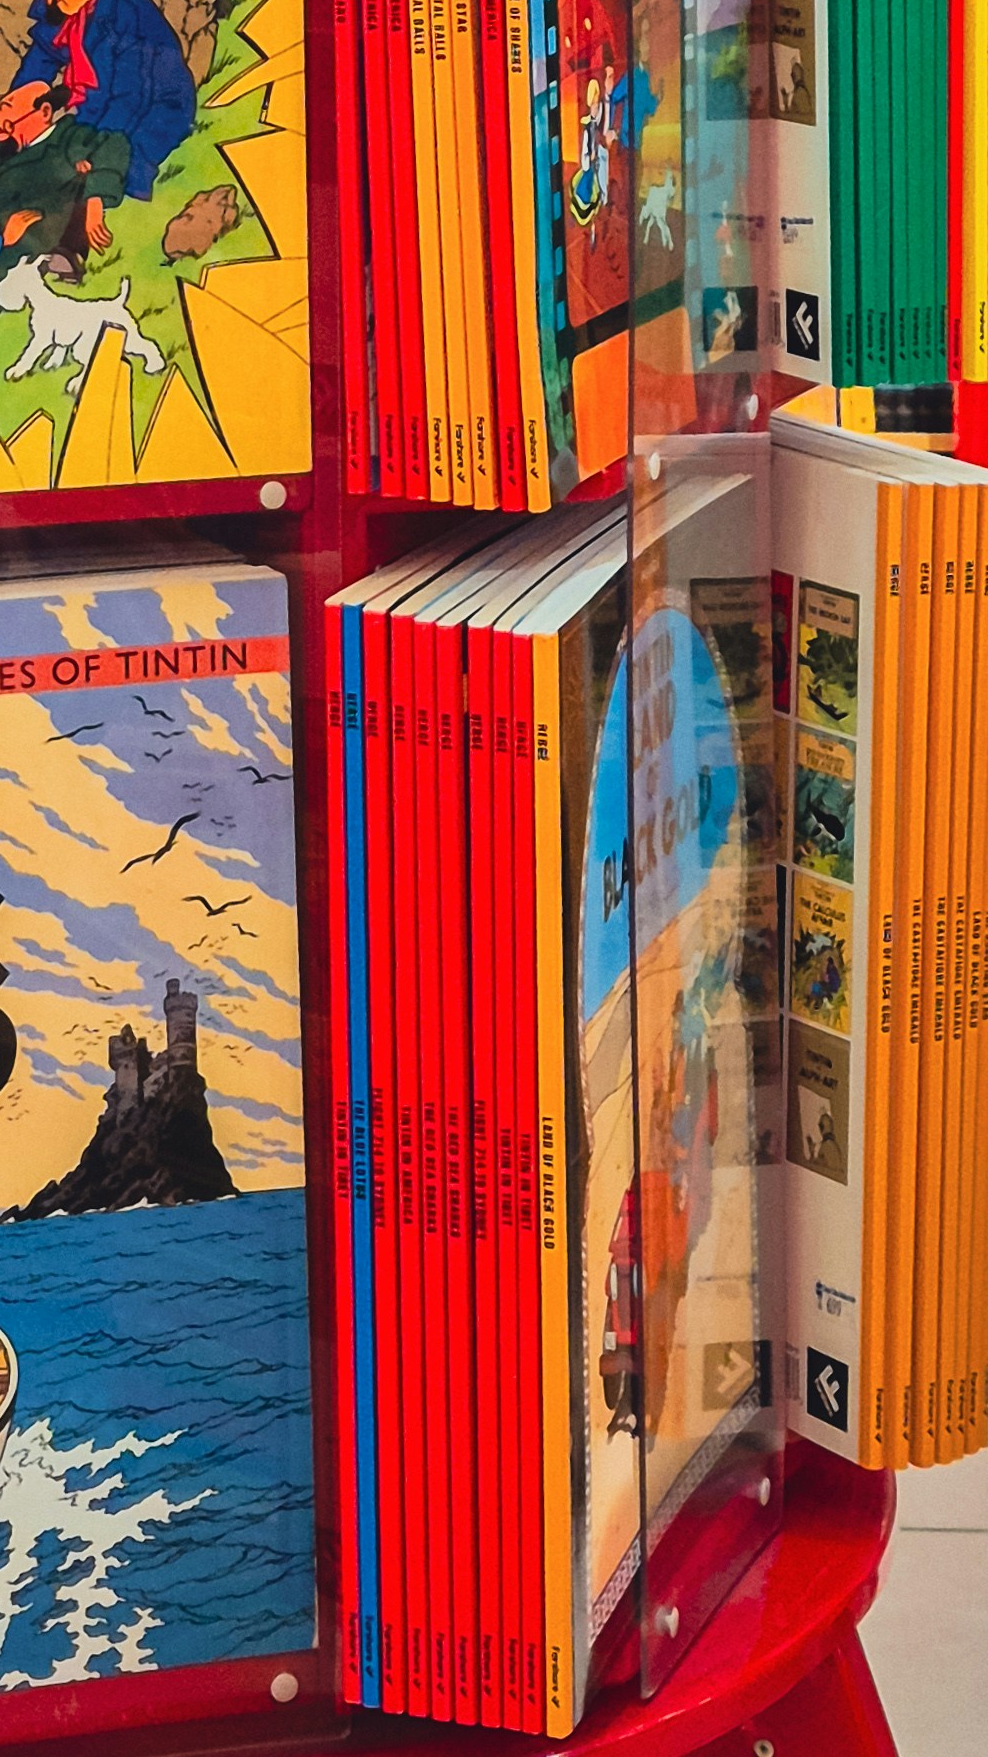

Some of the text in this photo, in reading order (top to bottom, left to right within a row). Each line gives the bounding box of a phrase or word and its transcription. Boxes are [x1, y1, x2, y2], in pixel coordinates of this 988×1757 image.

[456, 3, 468, 33] STAR
[510, 7, 520, 20] OF
[413, 19, 425, 55] BALLS
[434, 25, 446, 61] BALLS
[511, 27, 522, 74] SHARKS
[51, 654, 101, 686] OF
[114, 642, 249, 679] TINTIN
